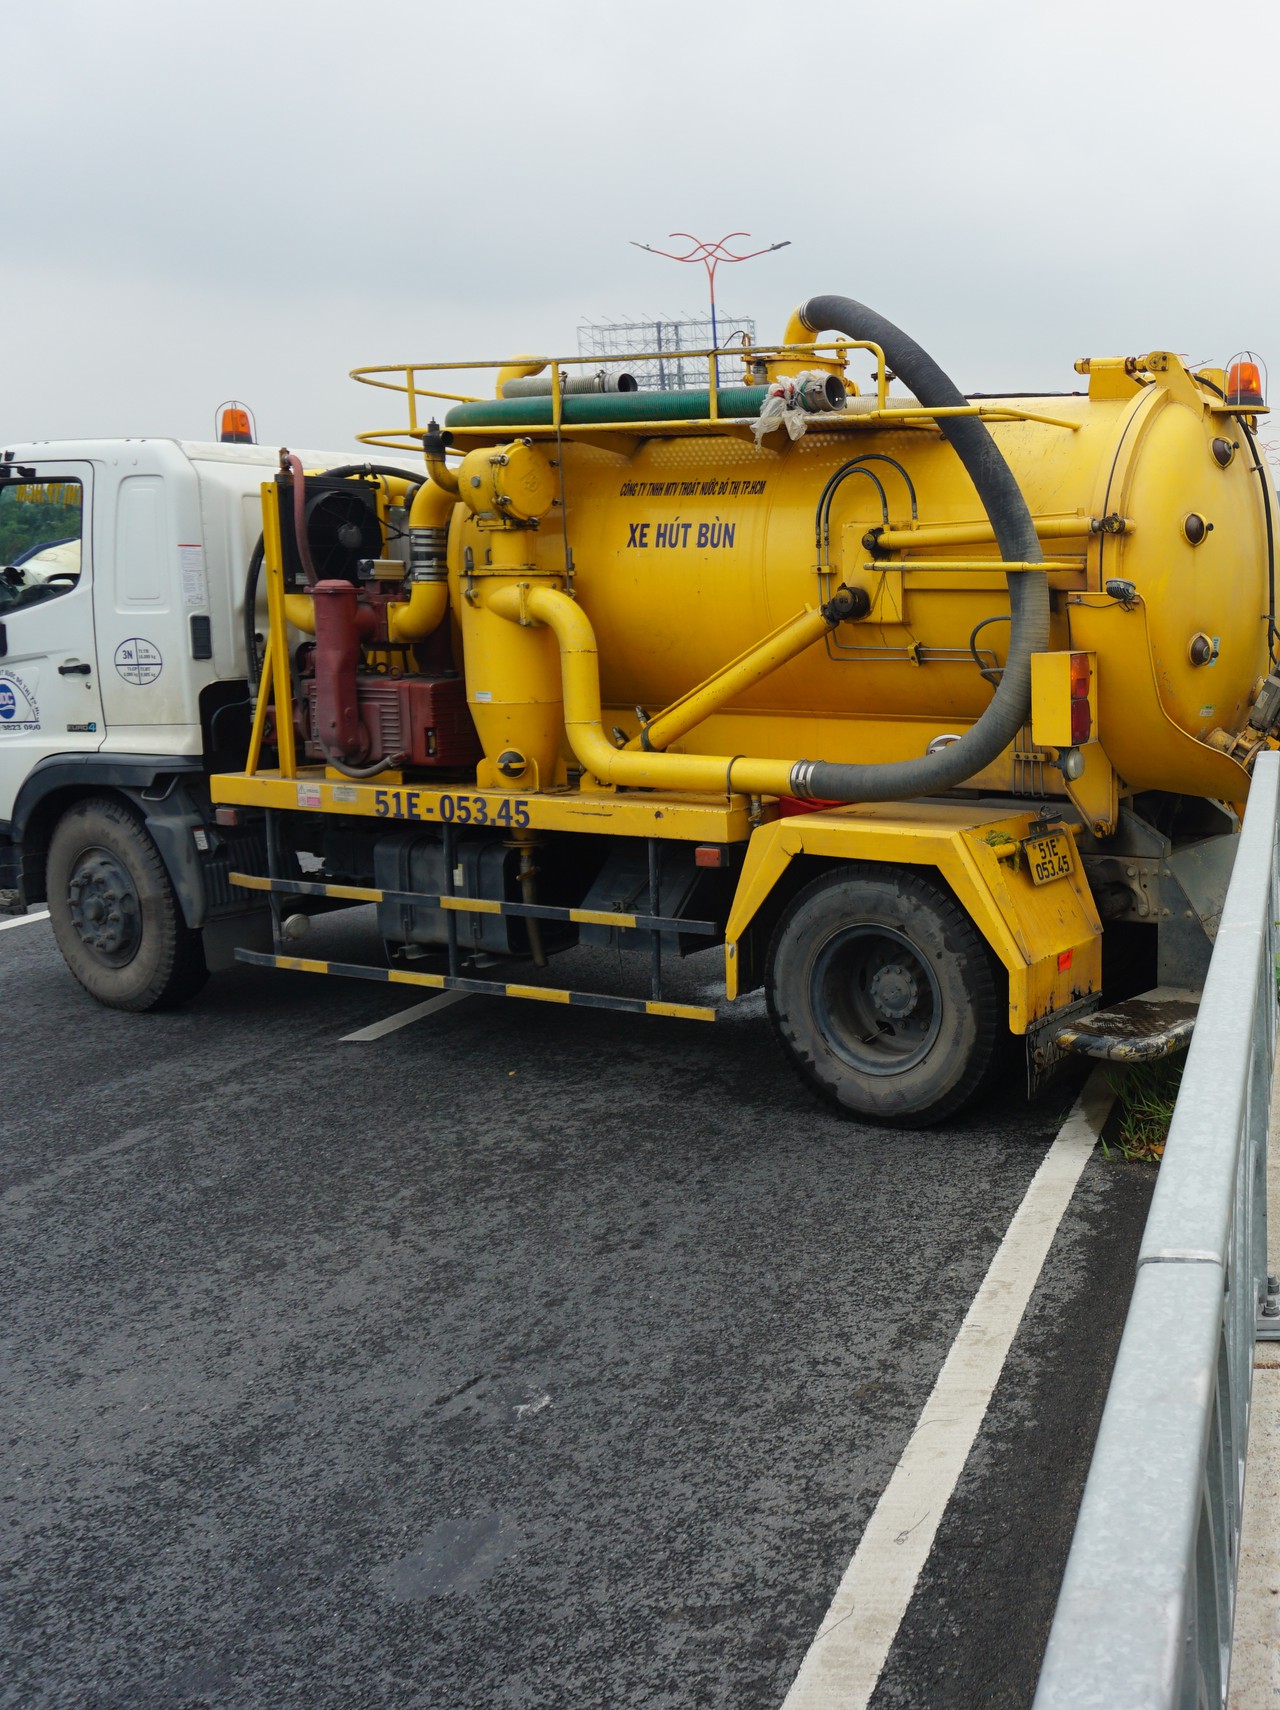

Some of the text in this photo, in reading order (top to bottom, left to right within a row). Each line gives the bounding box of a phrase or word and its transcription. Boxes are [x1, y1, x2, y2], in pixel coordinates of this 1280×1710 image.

[620, 479, 638, 496] CÔNG
[637, 482, 648, 496] TY
[647, 482, 665, 496] TNHH
[663, 481, 680, 496] MTV
[678, 478, 701, 496] THOÁT
[729, 480, 741, 498] THỊ
[626, 516, 736, 548] XE HÚT BÙN
[1038, 839, 1059, 859] 51E
[1035, 855, 1070, 880] 053.45
